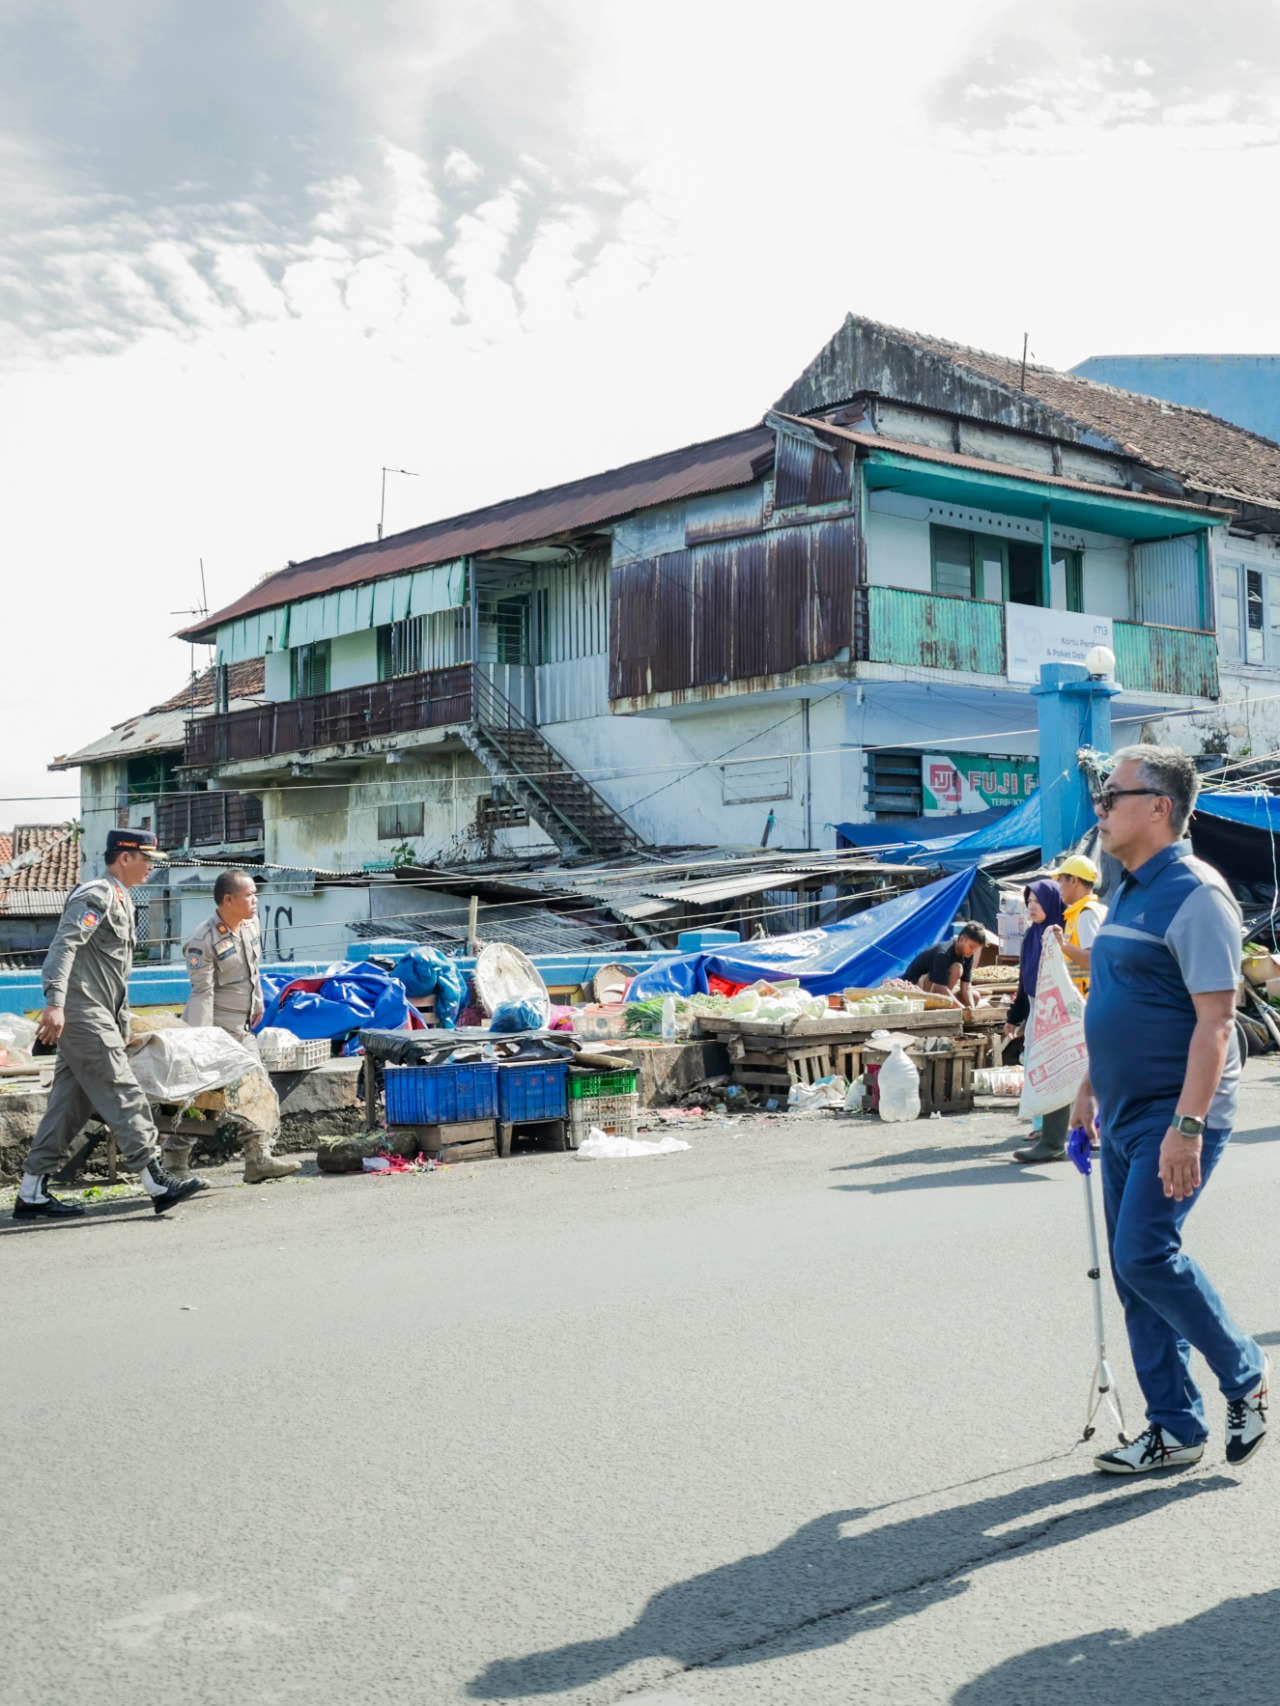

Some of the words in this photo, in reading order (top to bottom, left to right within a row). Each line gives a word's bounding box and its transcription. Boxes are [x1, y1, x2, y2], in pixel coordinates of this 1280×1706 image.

[1061, 637, 1079, 647] Kartu
[1046, 648, 1052, 656] &
[1053, 649, 1072, 658] Paket
[968, 771, 1018, 795] FUJI
